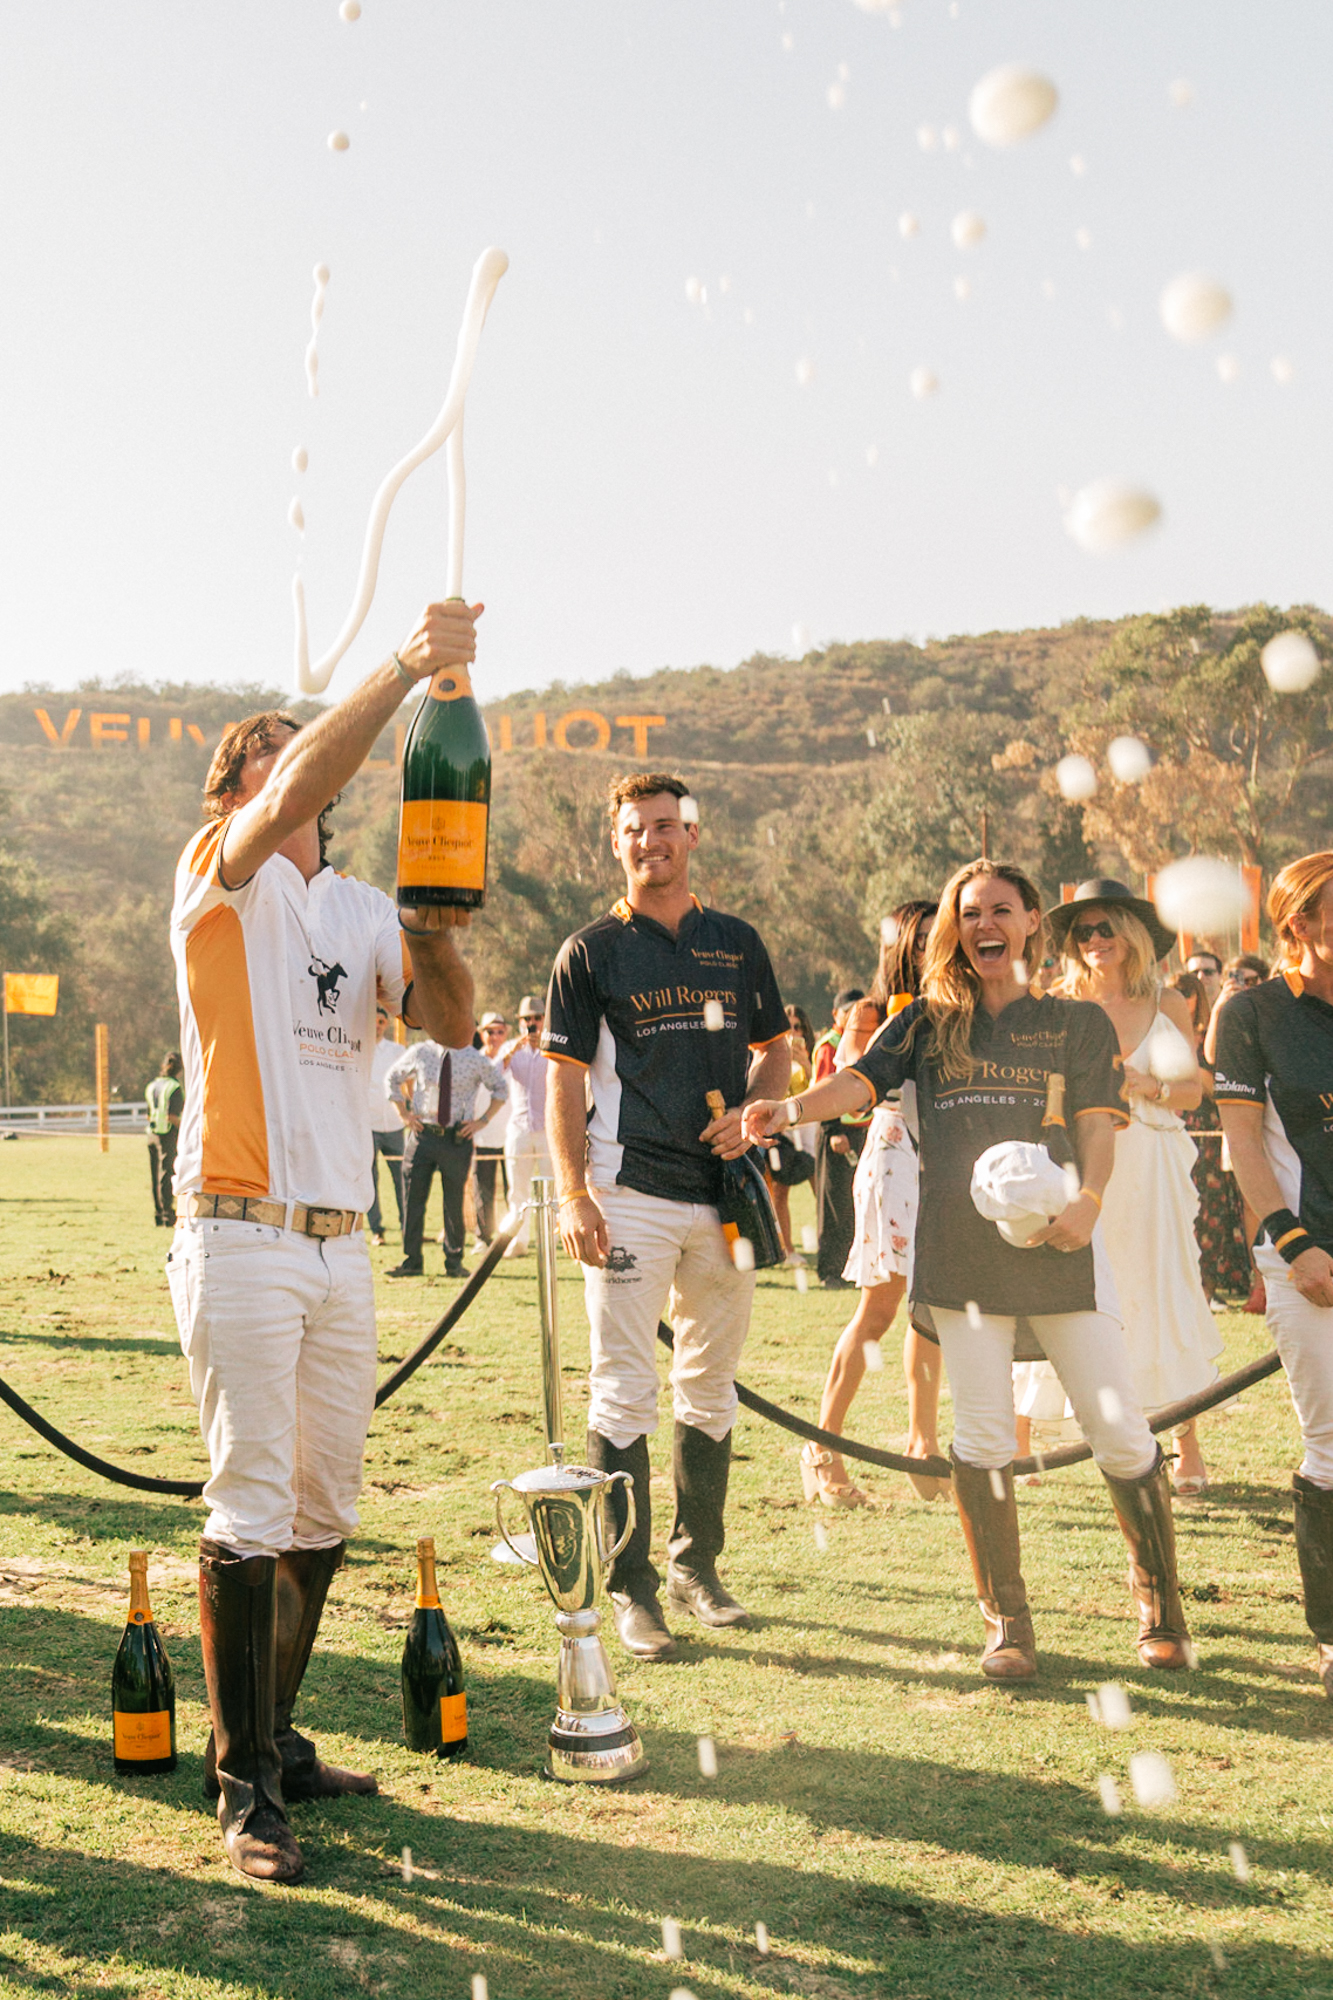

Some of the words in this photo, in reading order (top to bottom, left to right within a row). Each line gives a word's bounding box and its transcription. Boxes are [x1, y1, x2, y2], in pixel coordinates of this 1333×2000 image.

[630, 987, 672, 1012] Will
[676, 985, 738, 1005] Rogers
[293, 1020, 325, 1042] Veuve
[636, 1026, 657, 1038] LOS
[659, 1020, 706, 1032] ANGELES
[299, 1043, 327, 1056] POLO
[299, 1059, 315, 1067] LOS
[982, 1060, 1049, 1085] Roger
[934, 1099, 955, 1110] LOS
[957, 1094, 1016, 1105] ANGELES
